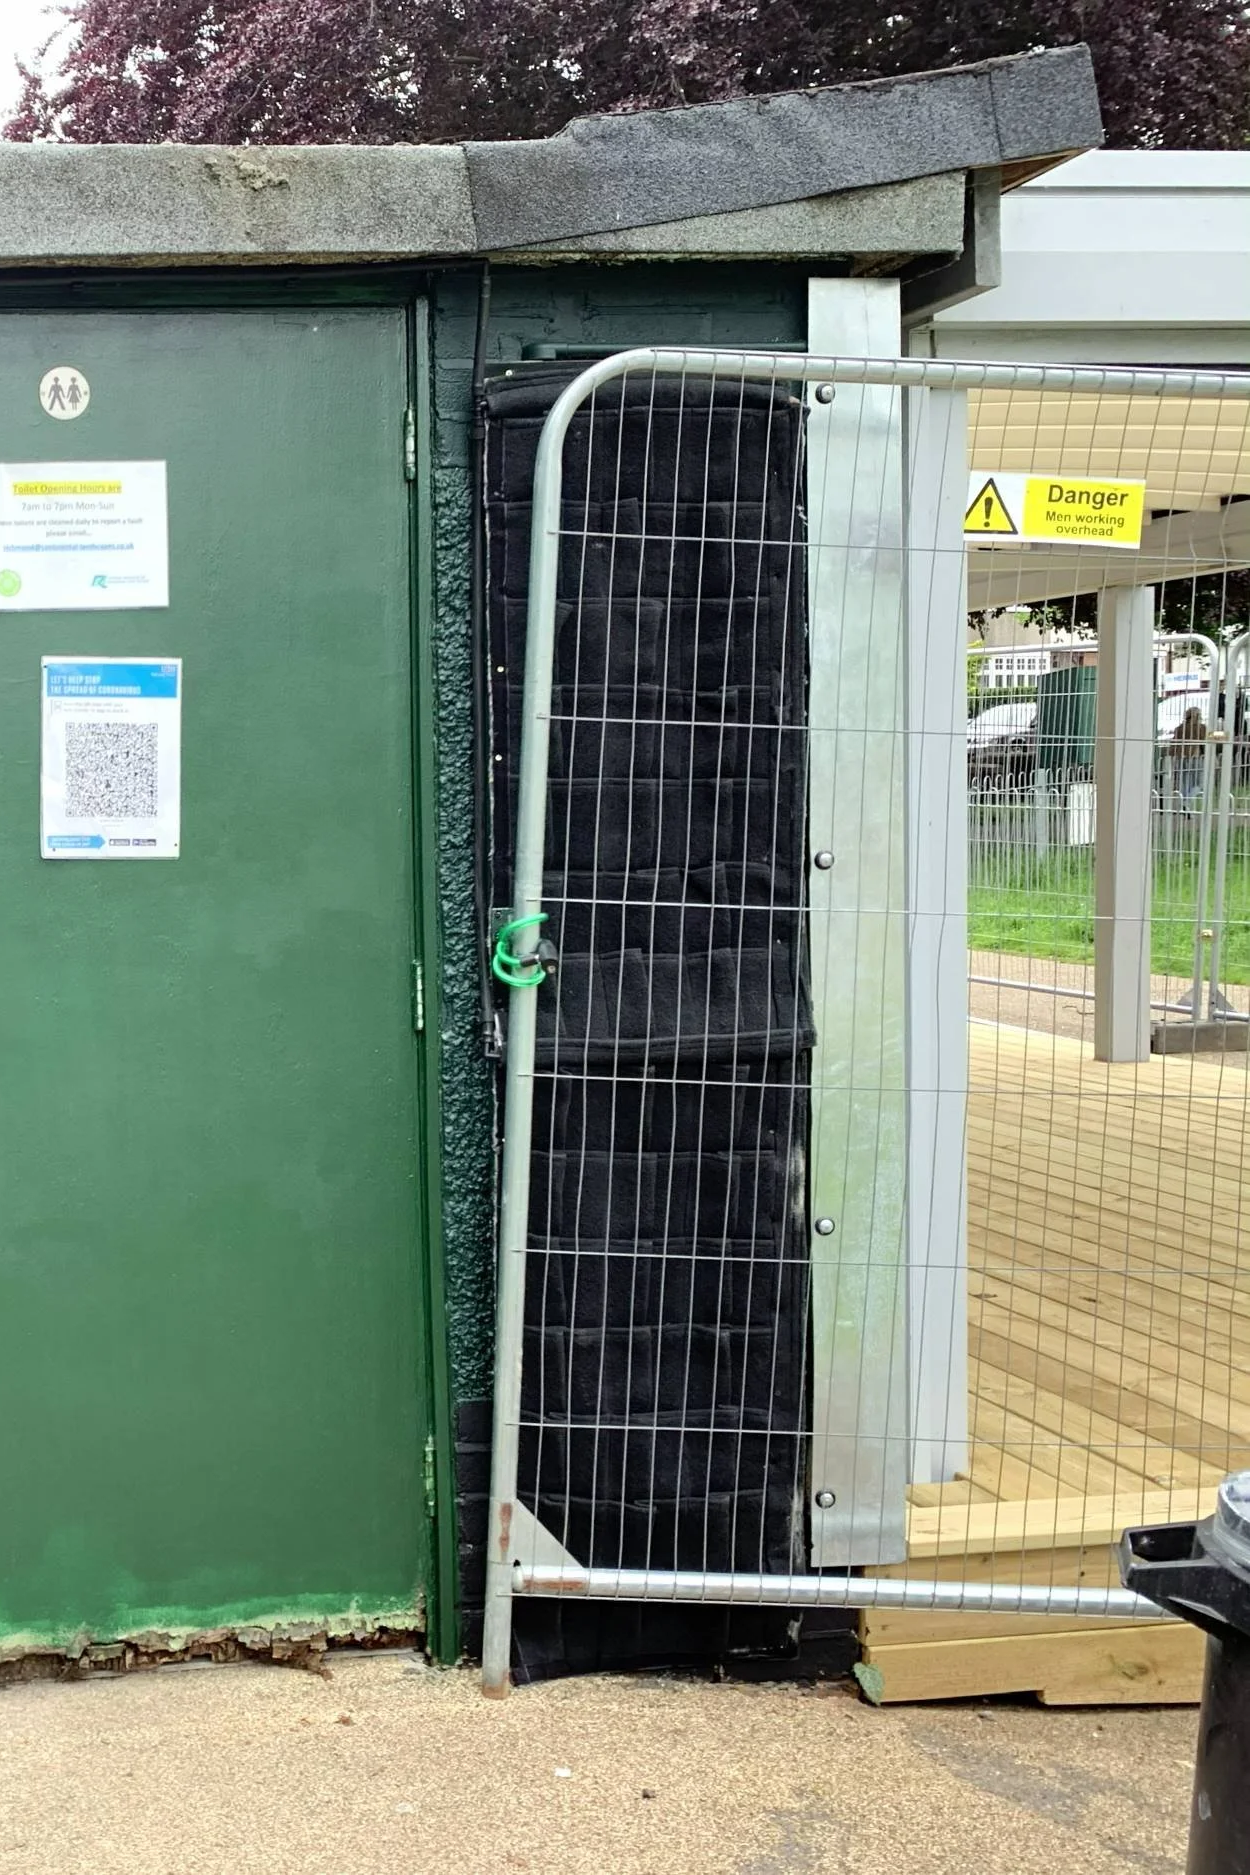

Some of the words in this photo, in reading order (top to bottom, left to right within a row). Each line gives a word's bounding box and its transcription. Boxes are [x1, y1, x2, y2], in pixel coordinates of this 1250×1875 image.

[13, 483, 38, 494] Toilet
[40, 483, 77, 494] Opening
[79, 483, 105, 493] Hours
[108, 485, 122, 493] are
[1048, 484, 1129, 510] Danger
[22, 502, 40, 511] 7am
[43, 502, 52, 511] to
[54, 501, 73, 512] 7pm
[1045, 510, 1071, 523] Men
[1075, 513, 1125, 528] working
[1056, 524, 1114, 537] overhead
